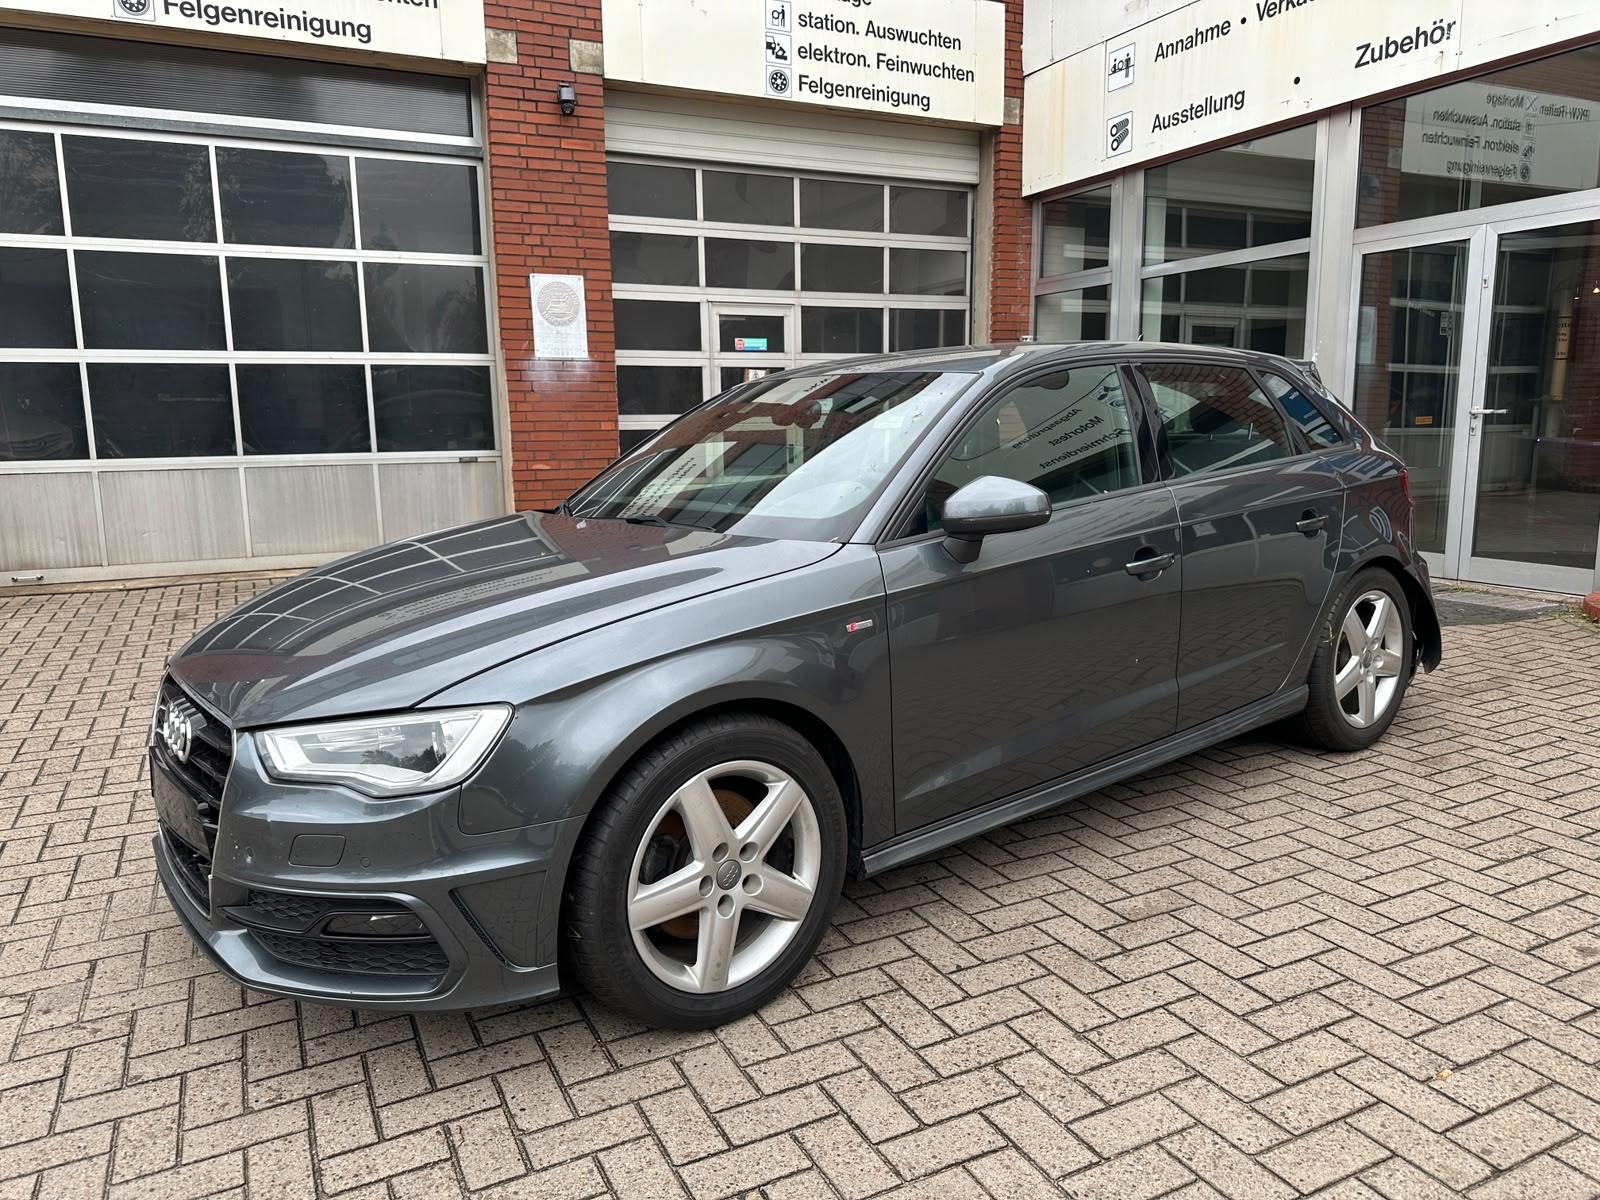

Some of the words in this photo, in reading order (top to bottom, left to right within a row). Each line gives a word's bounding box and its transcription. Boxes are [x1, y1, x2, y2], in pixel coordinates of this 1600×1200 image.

[163, 0, 372, 44] Felgenreinigung
[798, 11, 859, 35] station.
[865, 20, 961, 51] Auswuchten
[1154, 20, 1231, 63] Annahme
[797, 42, 870, 69] elektron.
[876, 52, 975, 83] Feinwuchten
[1151, 90, 1246, 134] Ausstellung
[1354, 18, 1456, 69] Zubehör
[798, 74, 930, 112] Felgenreinigung
